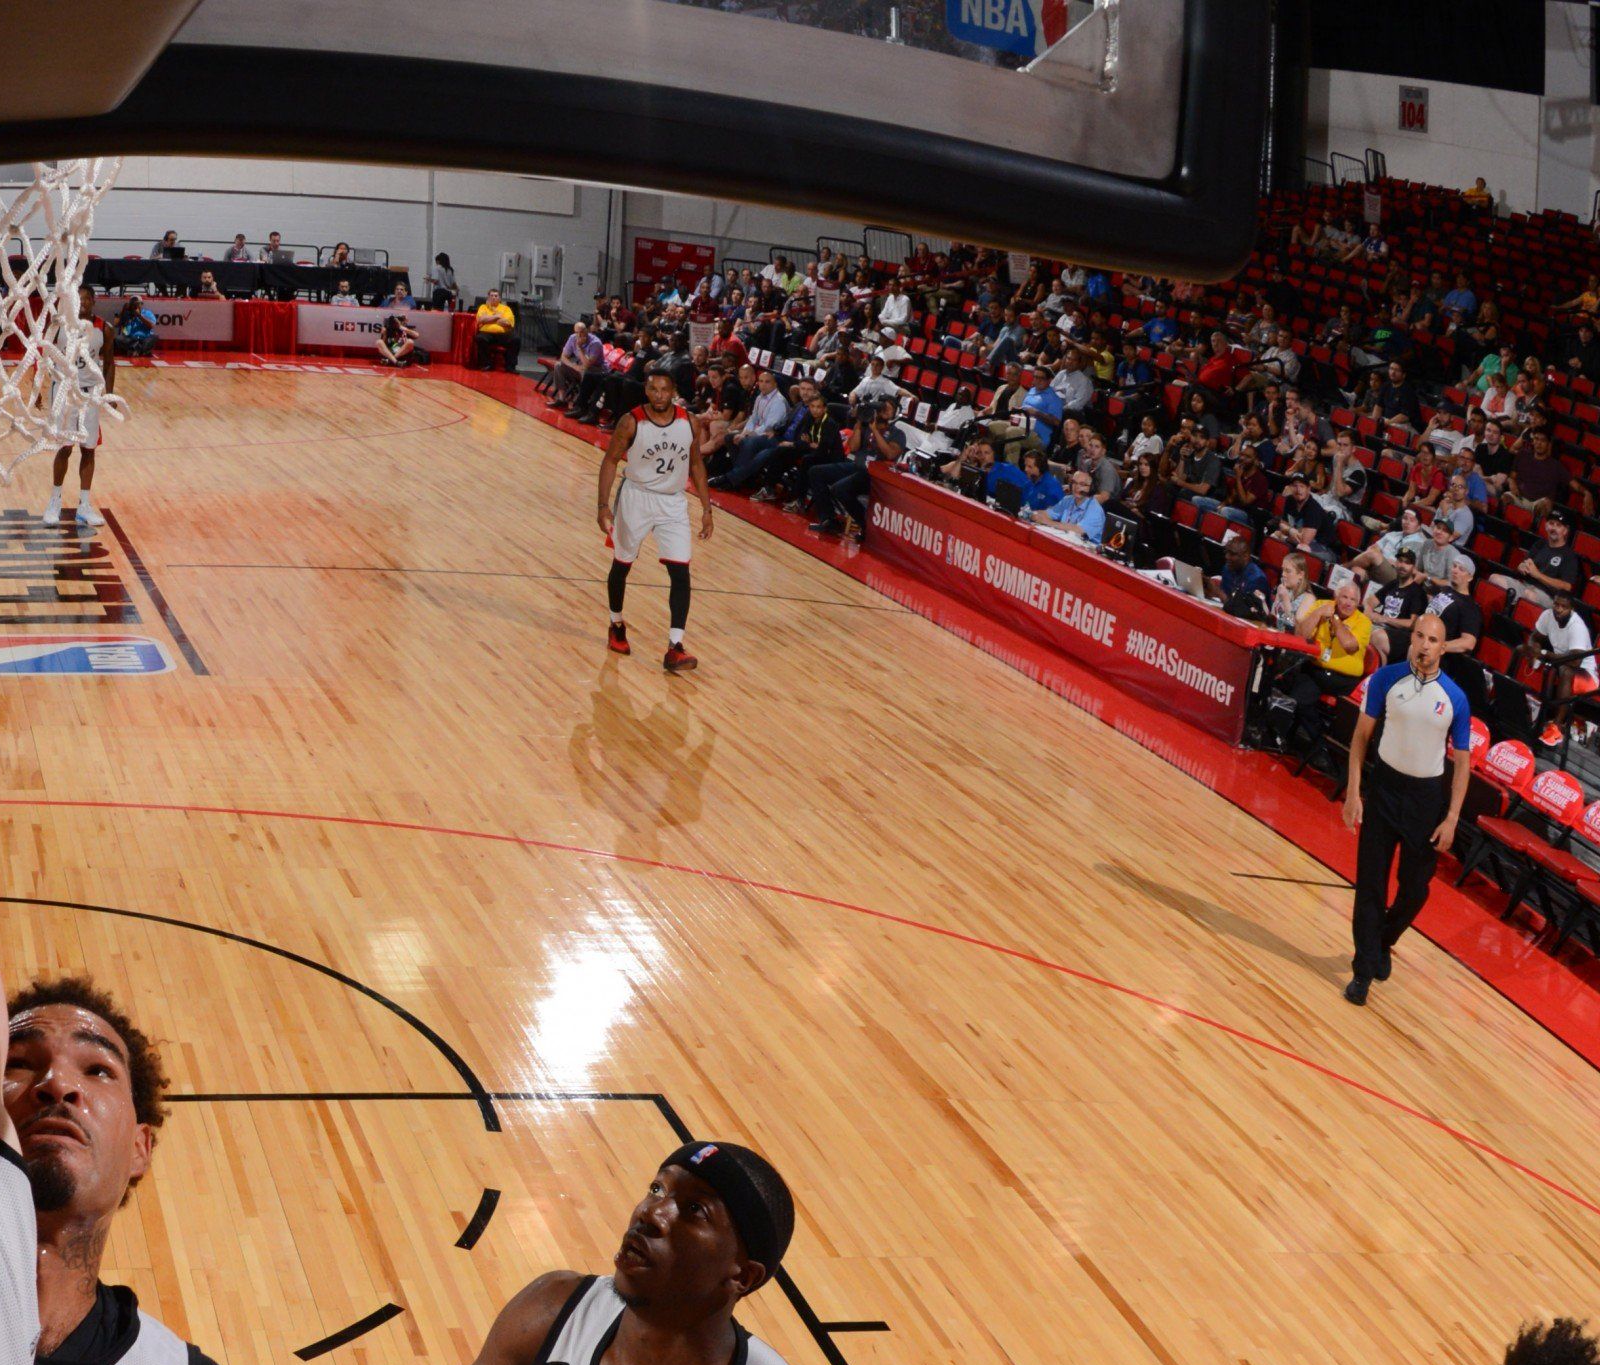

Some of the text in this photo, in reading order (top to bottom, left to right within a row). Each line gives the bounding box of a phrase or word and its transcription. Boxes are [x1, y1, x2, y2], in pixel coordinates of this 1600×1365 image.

[960, 0, 1029, 37] NBA
[1401, 101, 1425, 129] 104
[641, 441, 688, 461] TORONTO
[656, 458, 675, 474] 24
[872, 502, 1234, 707] SAMSUNG NBA SUMMER LEAGUE #NBASummer
[1541, 785, 1569, 810] LEAGUE
[1547, 778, 1580, 803] SUMMER
